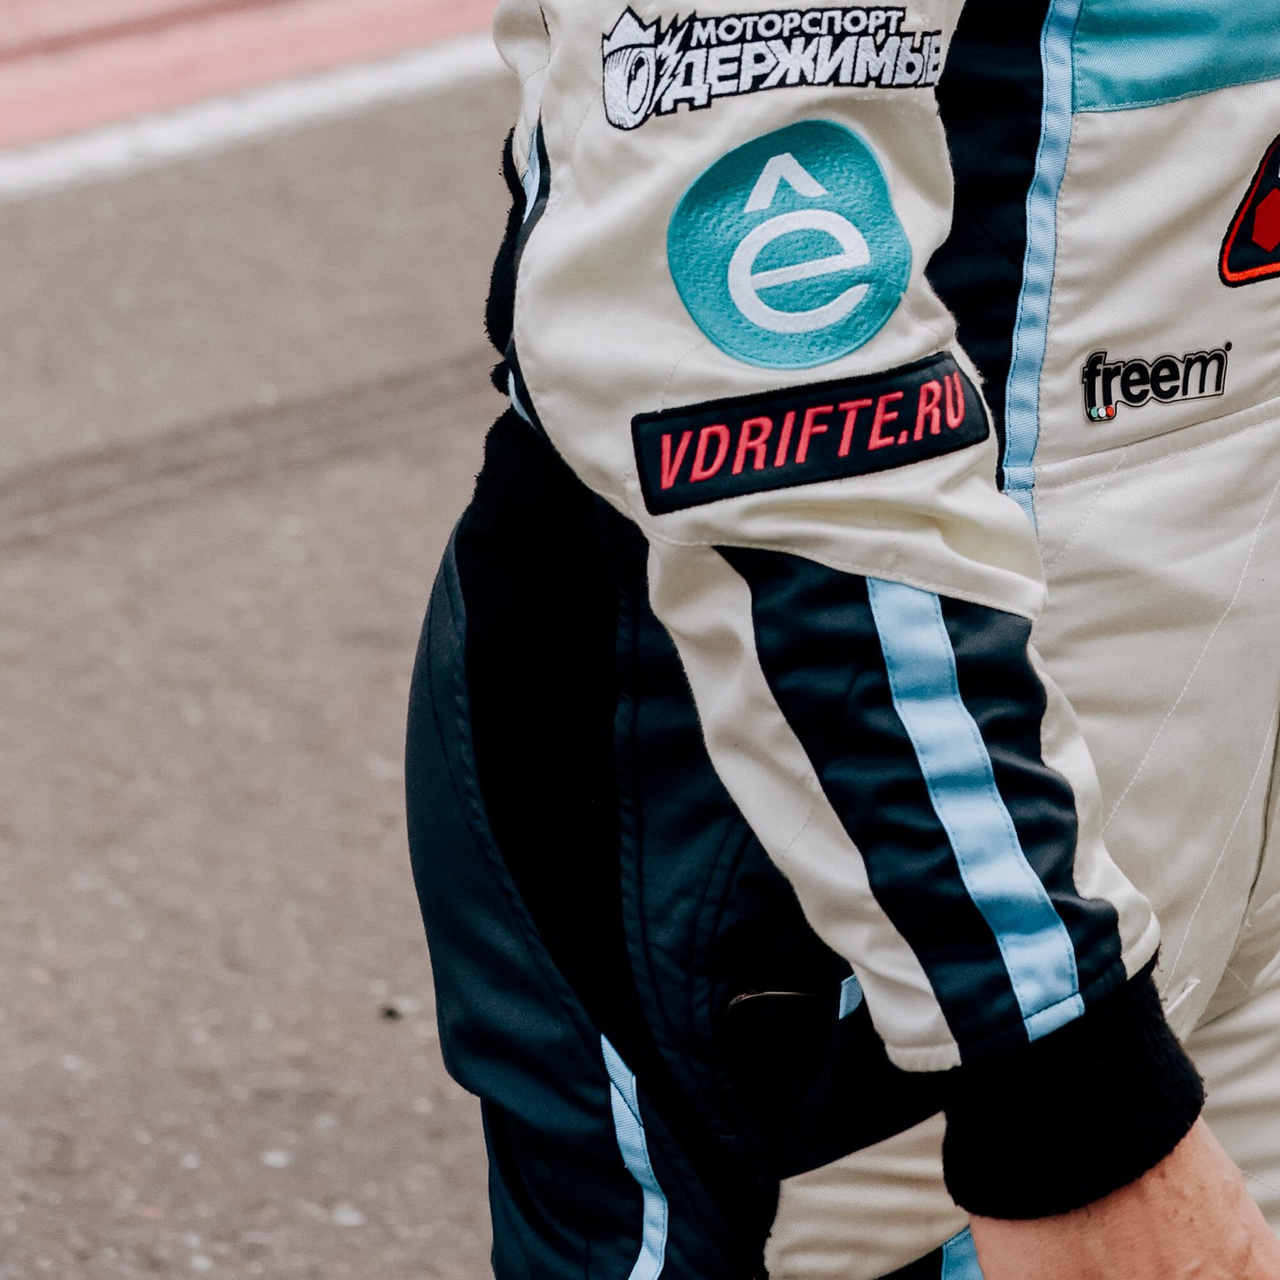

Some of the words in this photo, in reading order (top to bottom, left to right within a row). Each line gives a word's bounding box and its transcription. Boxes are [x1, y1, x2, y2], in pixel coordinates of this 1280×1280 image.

[690, 10, 904, 47] МОТОРСПОРТ
[1084, 350, 1227, 419] freem
[659, 371, 967, 491] VDRIFTE.RU
